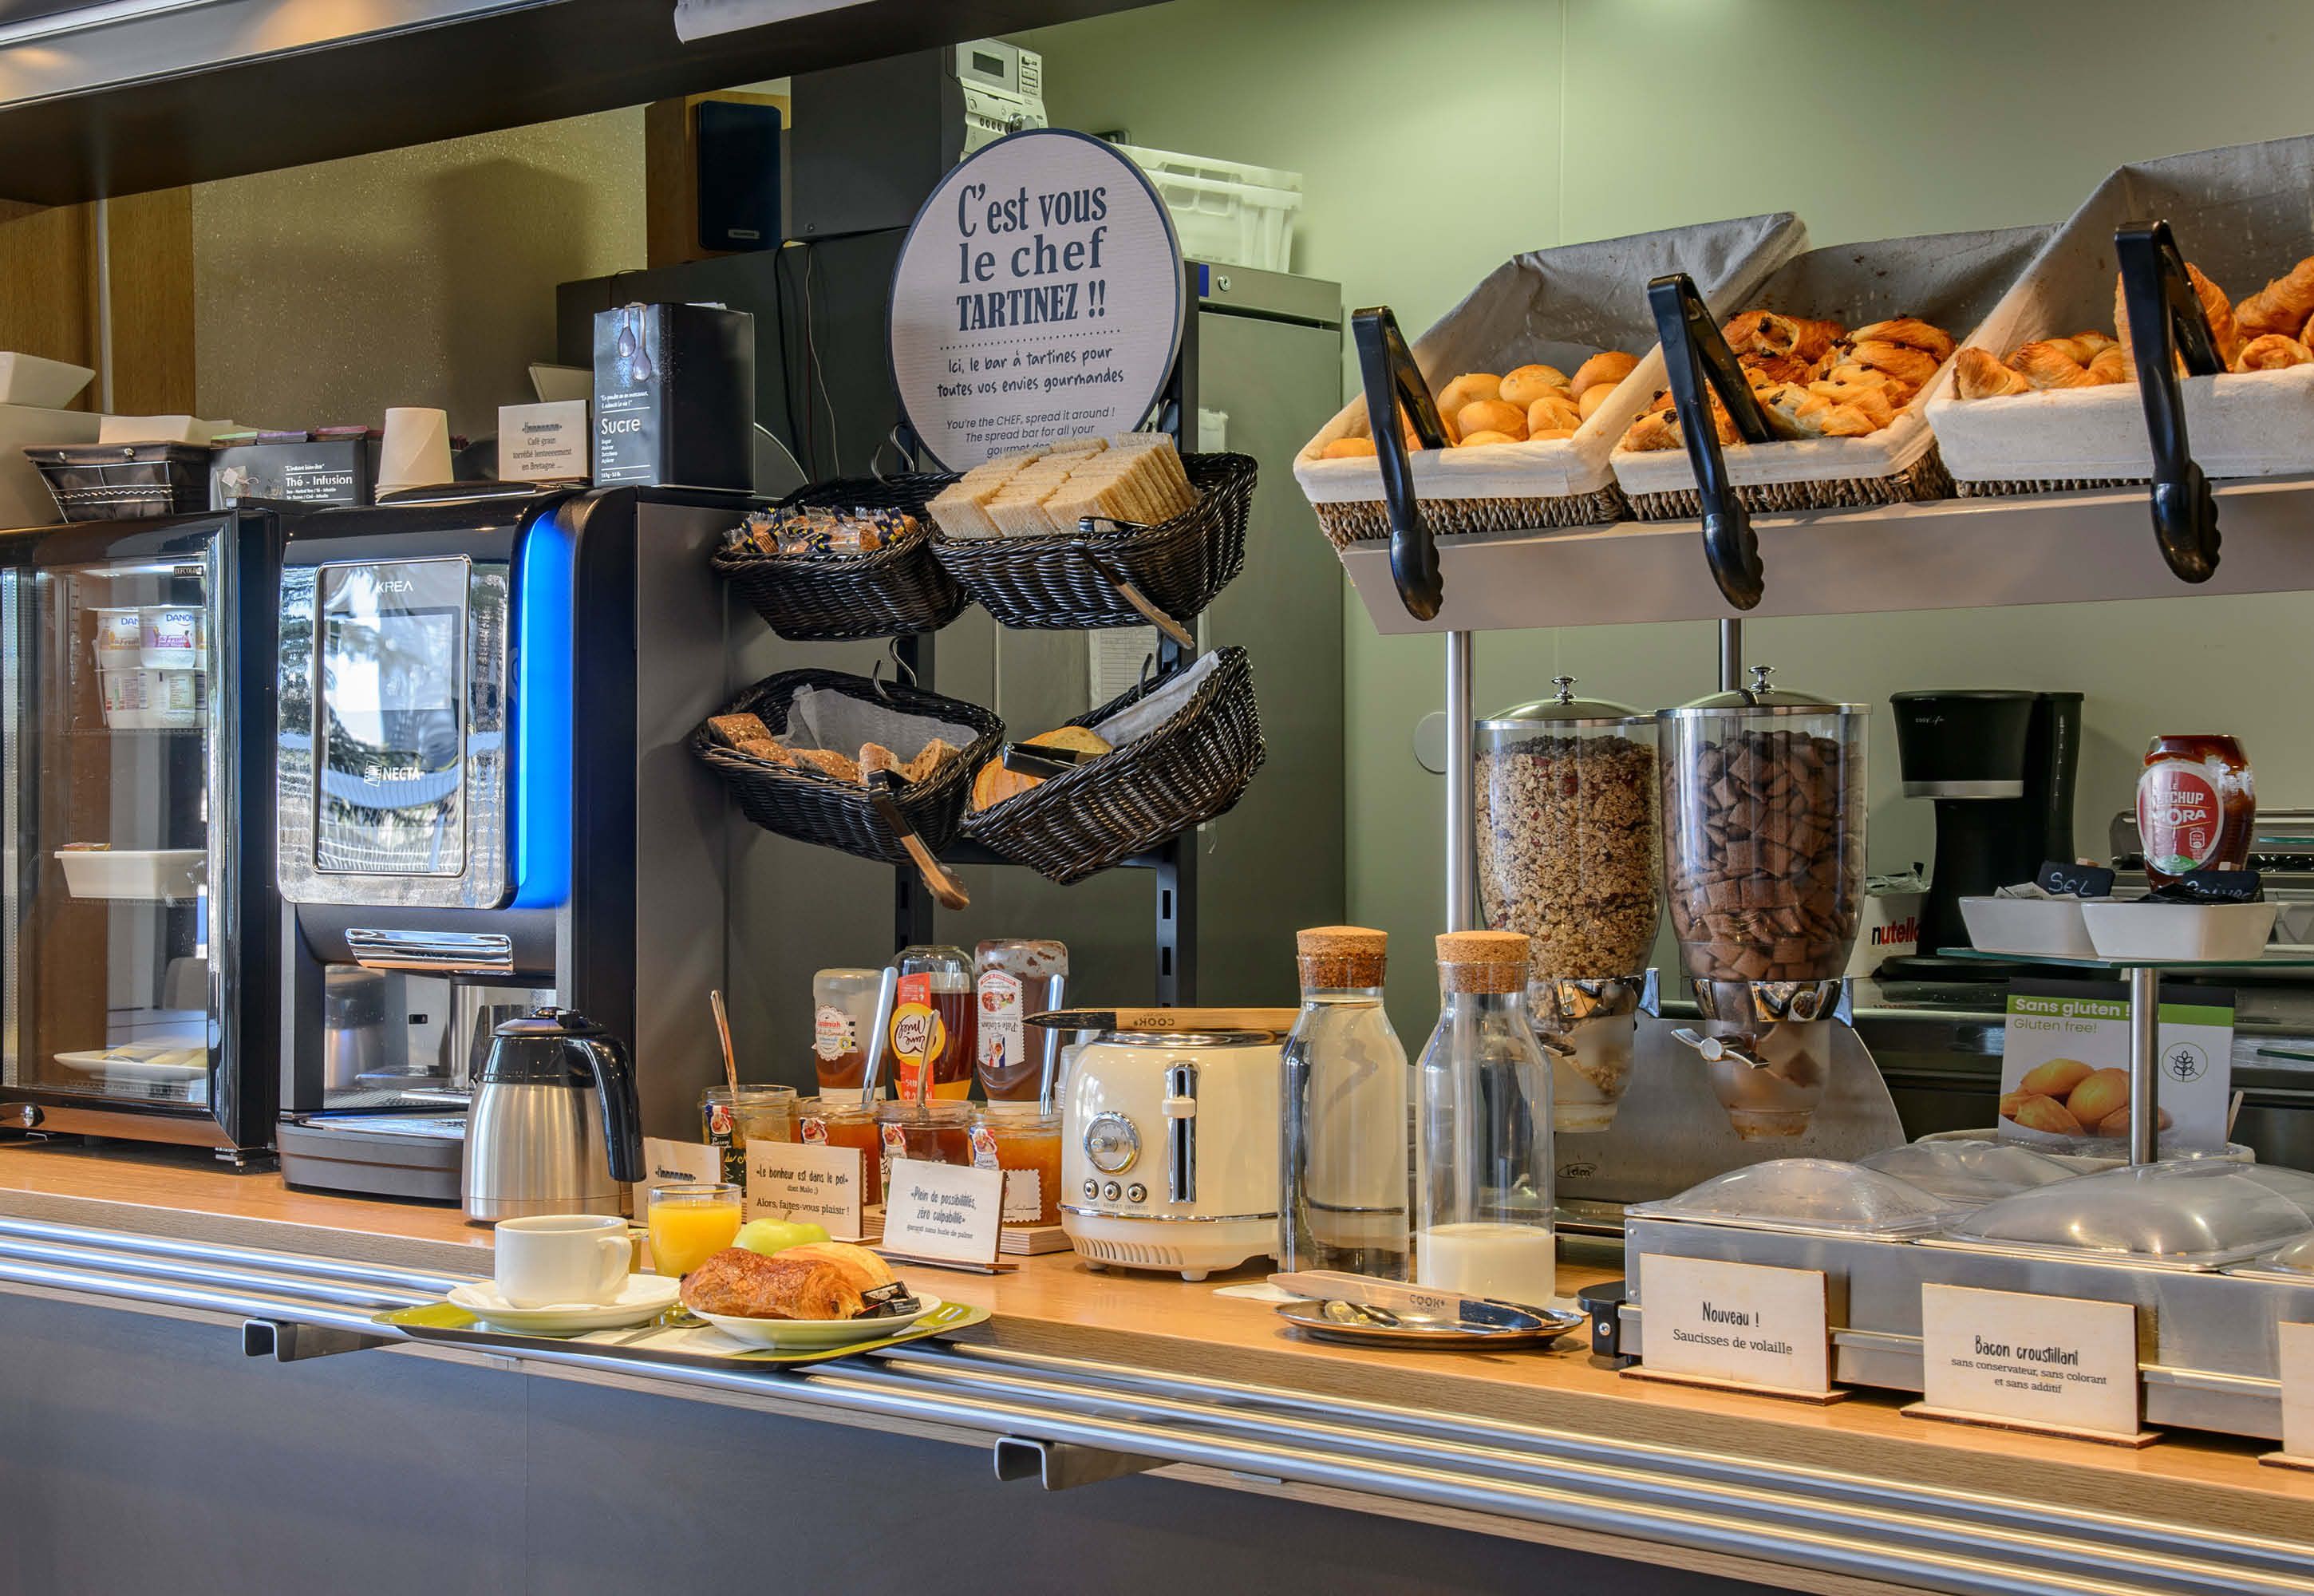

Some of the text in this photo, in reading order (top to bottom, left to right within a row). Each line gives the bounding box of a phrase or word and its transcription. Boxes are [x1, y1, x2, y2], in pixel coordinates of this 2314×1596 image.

[958, 184, 1107, 237] C'est vous
[959, 226, 1108, 284] le chef
[957, 280, 1106, 331] TARTINEZ !!
[948, 346, 1113, 375] Ici, le bar à tartines pour
[937, 370, 1124, 398] toutes vos envies gourmandes
[601, 417, 641, 435] Sucre
[946, 419, 976, 430] You're
[978, 417, 994, 428] the
[997, 414, 1023, 426] CHEF,
[1025, 412, 1060, 426] spread
[1063, 410, 1070, 421] it
[1072, 408, 1109, 420] around
[965, 424, 1095, 443] The spread bar for all your
[286, 476, 303, 487] Thé
[313, 474, 353, 486] Infusion
[375, 580, 413, 594] KREA
[383, 767, 421, 782] NECTA
[2016, 998, 2058, 1013] Sans
[2062, 1001, 2121, 1018] gluten
[2013, 1017, 2099, 1034] Gluten free!
[769, 1167, 794, 1180] bonheur
[798, 1171, 807, 1182] est
[809, 1171, 824, 1183] dans
[827, 1171, 832, 1183] le
[930, 1190, 938, 1203] de
[756, 1198, 778, 1208] Alors,
[780, 1200, 820, 1212] faites-vous
[821, 1203, 846, 1215] plaisir
[917, 1207, 930, 1220] zéro
[1702, 1302, 1759, 1328] Nouveau !
[1672, 1329, 1793, 1355] Saucisses de volaille
[1975, 1335, 2079, 1367] Bacon croustillant
[1951, 1358, 2107, 1385] sans conservateur, sans colorant
[1994, 1377, 2063, 1394] et sans additif
